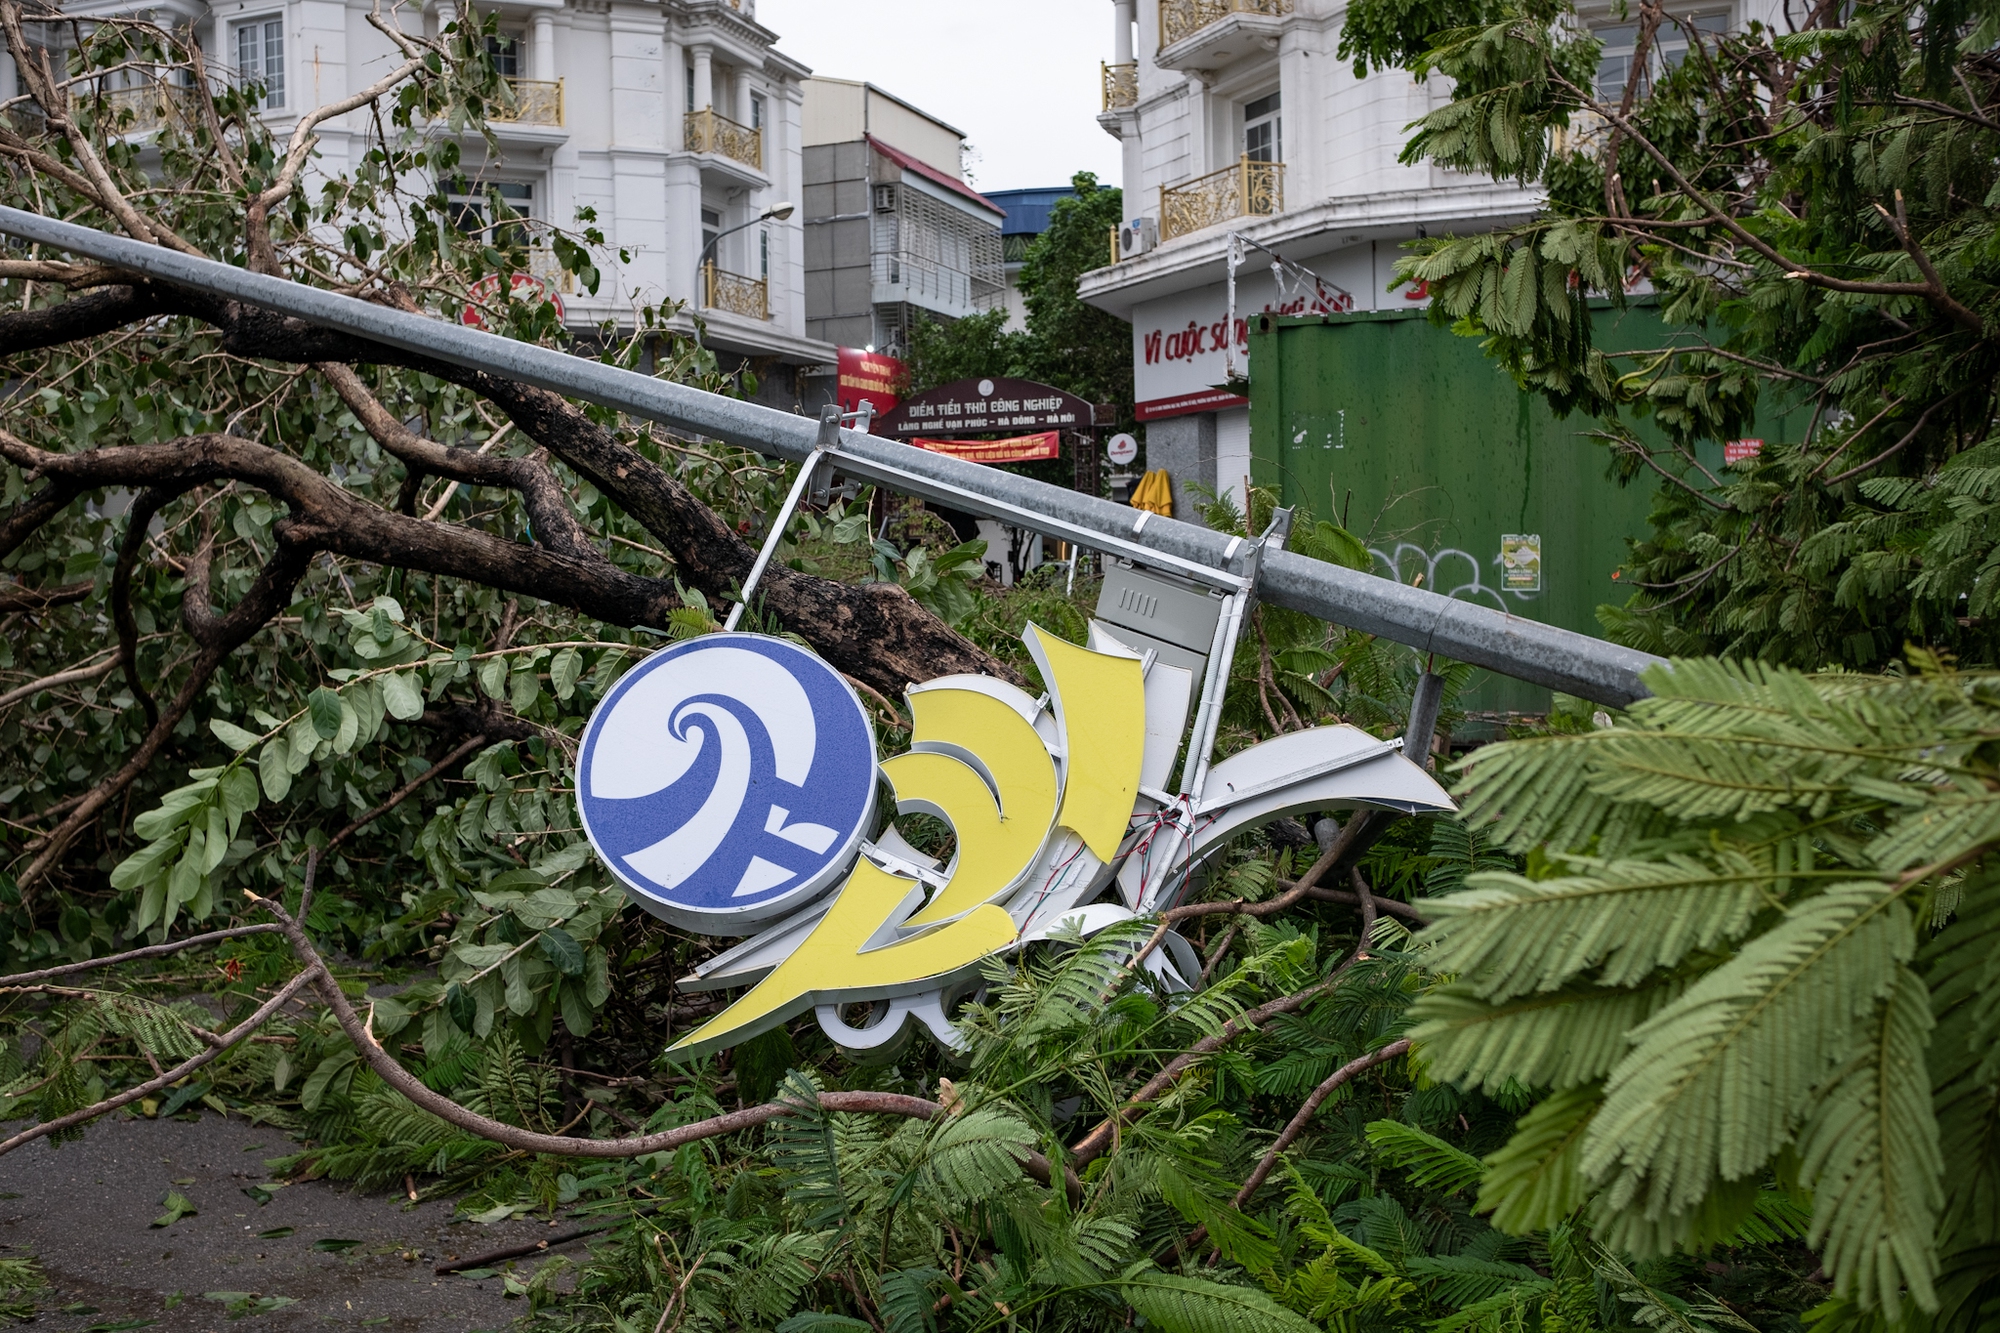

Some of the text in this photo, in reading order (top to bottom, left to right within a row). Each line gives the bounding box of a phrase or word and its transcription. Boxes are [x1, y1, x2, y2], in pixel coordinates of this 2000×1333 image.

[1144, 328, 1161, 365] Vì
[1165, 320, 1208, 363] cuộc
[909, 399, 935, 417] ĐIỂM
[964, 398, 987, 414] THỦ
[990, 397, 1019, 412] CÔNG
[1023, 395, 1063, 412] NGHIỆP
[898, 421, 920, 431] LÀNG
[945, 420, 962, 430] VẠN
[997, 416, 1010, 426] HÀ
[1046, 413, 1059, 424] HÀ
